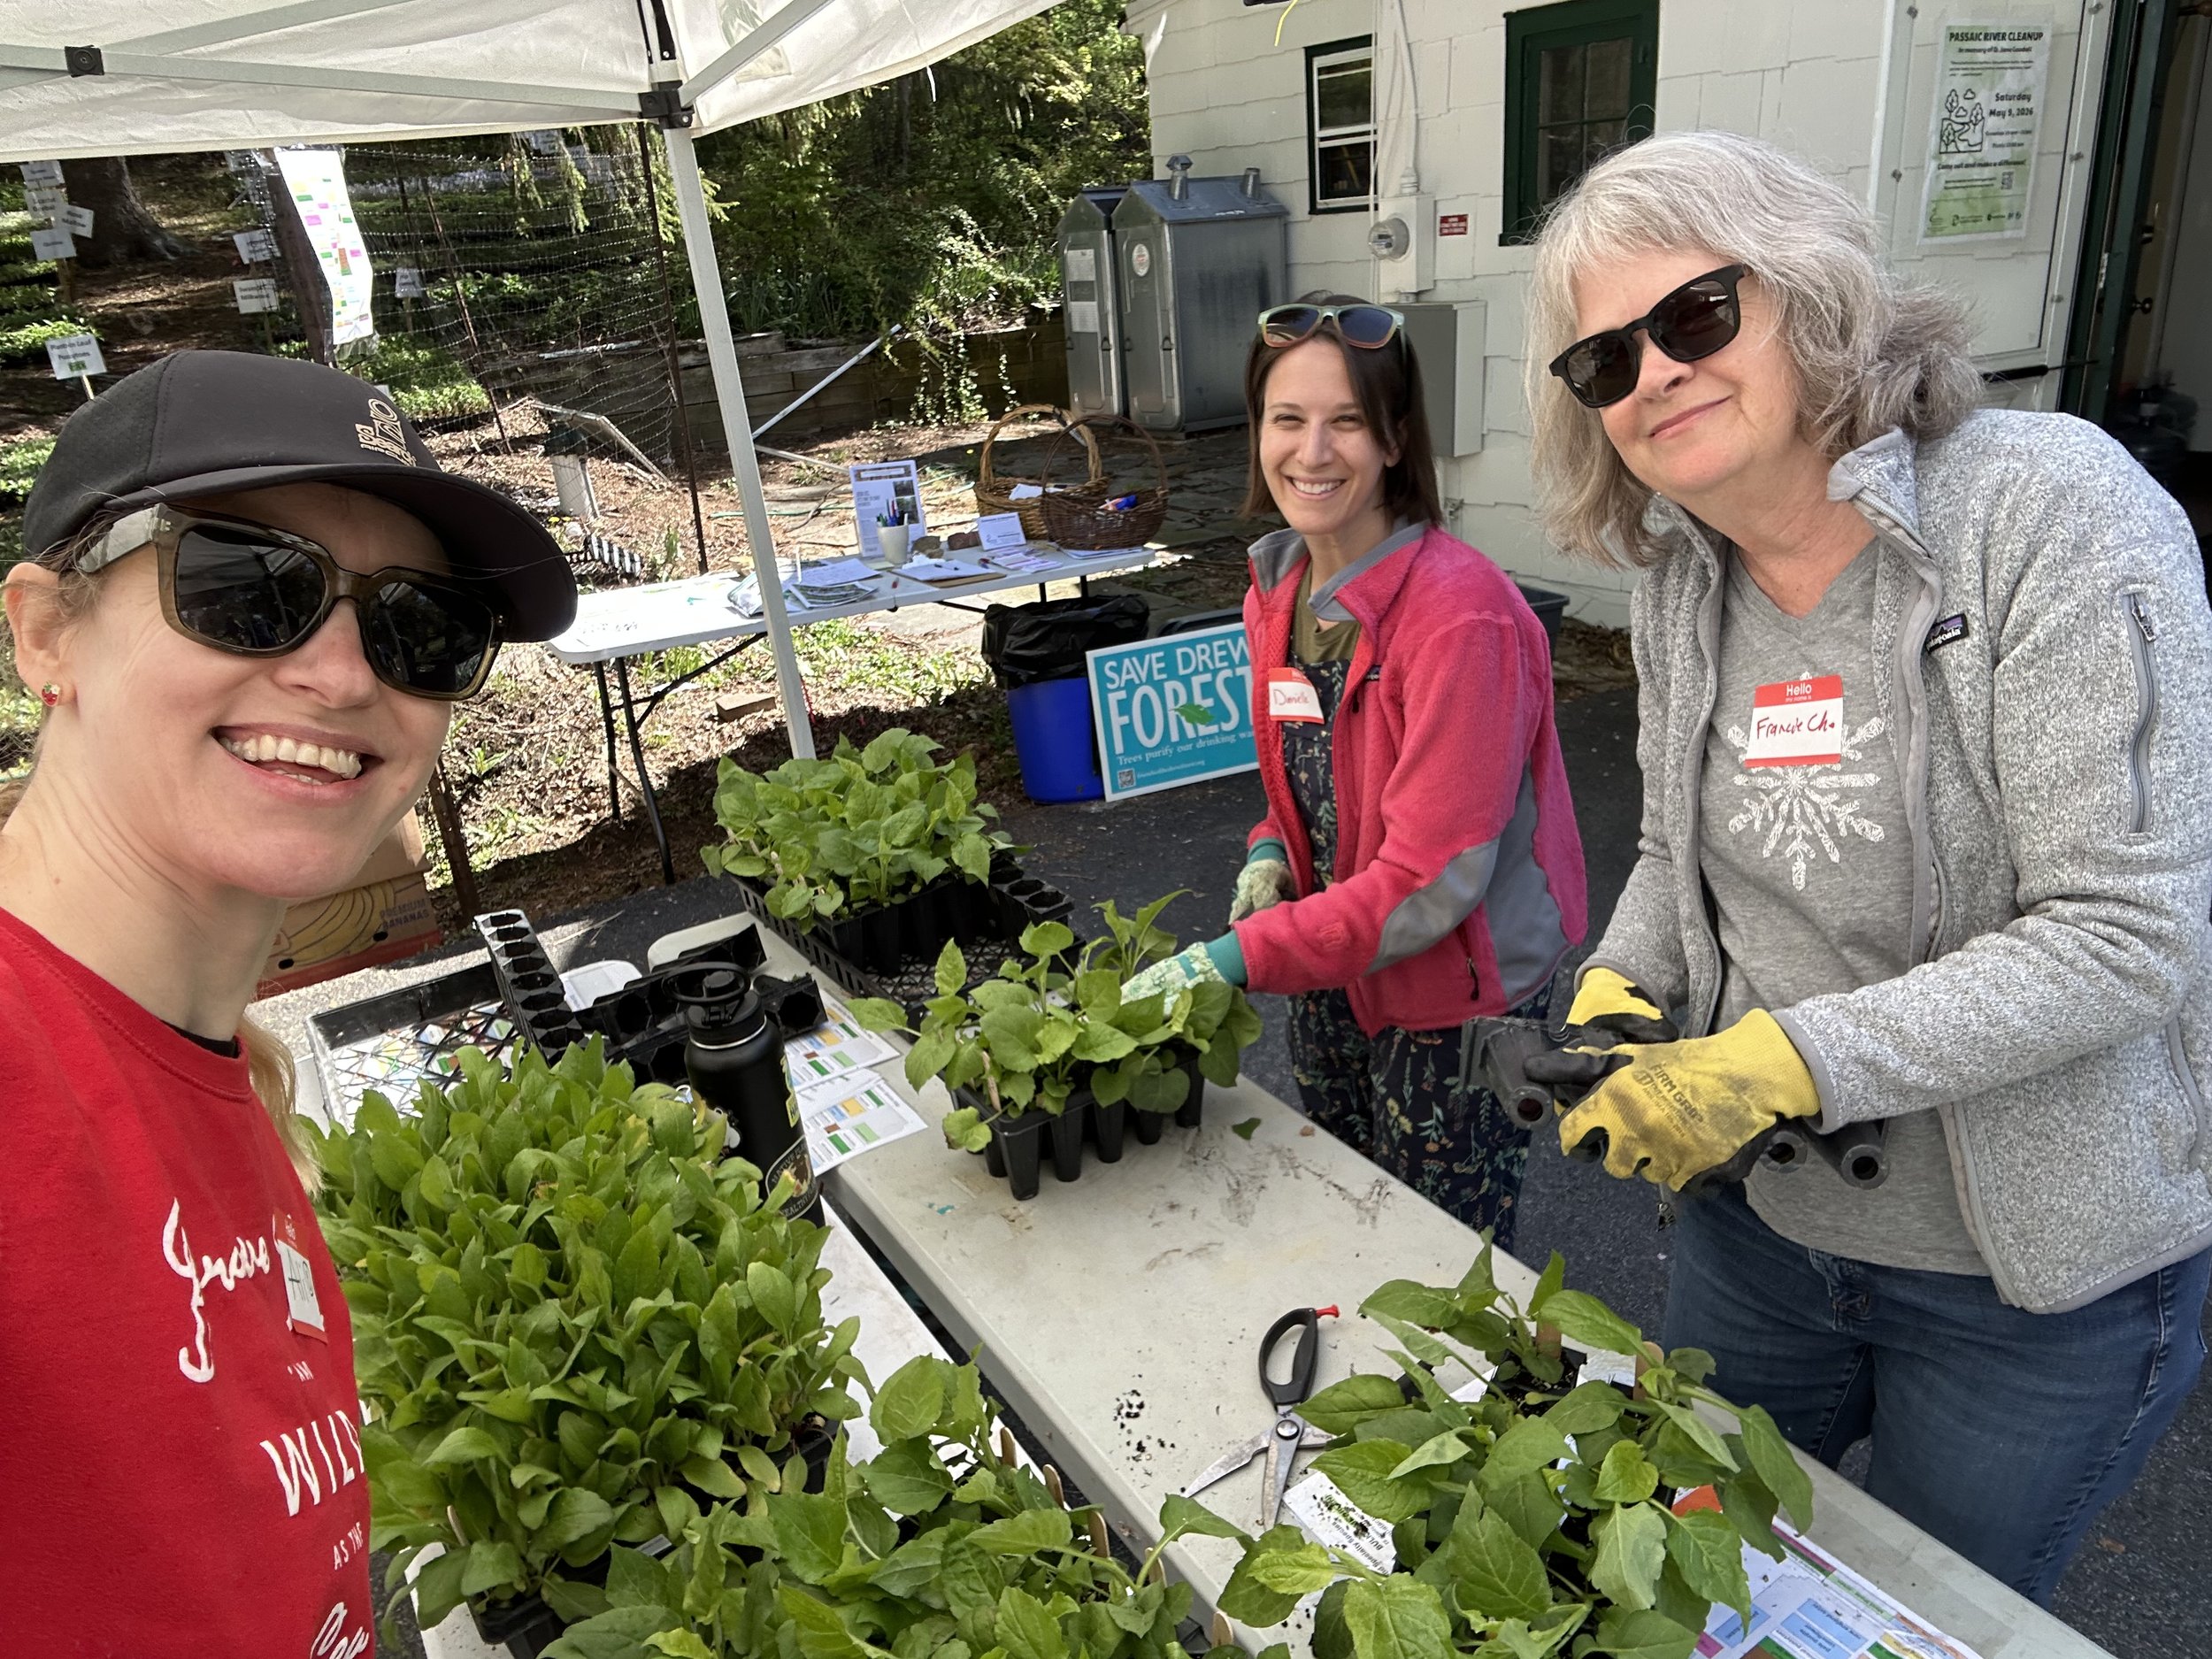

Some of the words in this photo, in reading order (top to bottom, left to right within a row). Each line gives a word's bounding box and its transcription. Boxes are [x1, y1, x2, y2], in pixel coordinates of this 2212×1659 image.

[1949, 32, 1982, 42] PASSAIC
[1984, 32, 2006, 41] RIVER
[2008, 31, 2043, 41] CLEANUP
[1995, 92, 2032, 102] Saturday
[1989, 109, 2006, 119] May
[2016, 108, 2034, 116] 2026
[1104, 651, 1167, 689] SAVE
[1786, 683, 1812, 696] Hello
[1107, 665, 1255, 755] FOREST
[1116, 755, 1143, 766] Trees
[1145, 746, 1174, 762] purify
[1177, 743, 1194, 752] our
[1196, 735, 1237, 749] drinking
[380, 897, 426, 919] PREMIUM
[381, 910, 431, 929] BANANAS
[1650, 1063, 1677, 1093] FIRM
[1673, 1091, 1704, 1123] GRIP
[333, 1539, 349, 1571] AS
